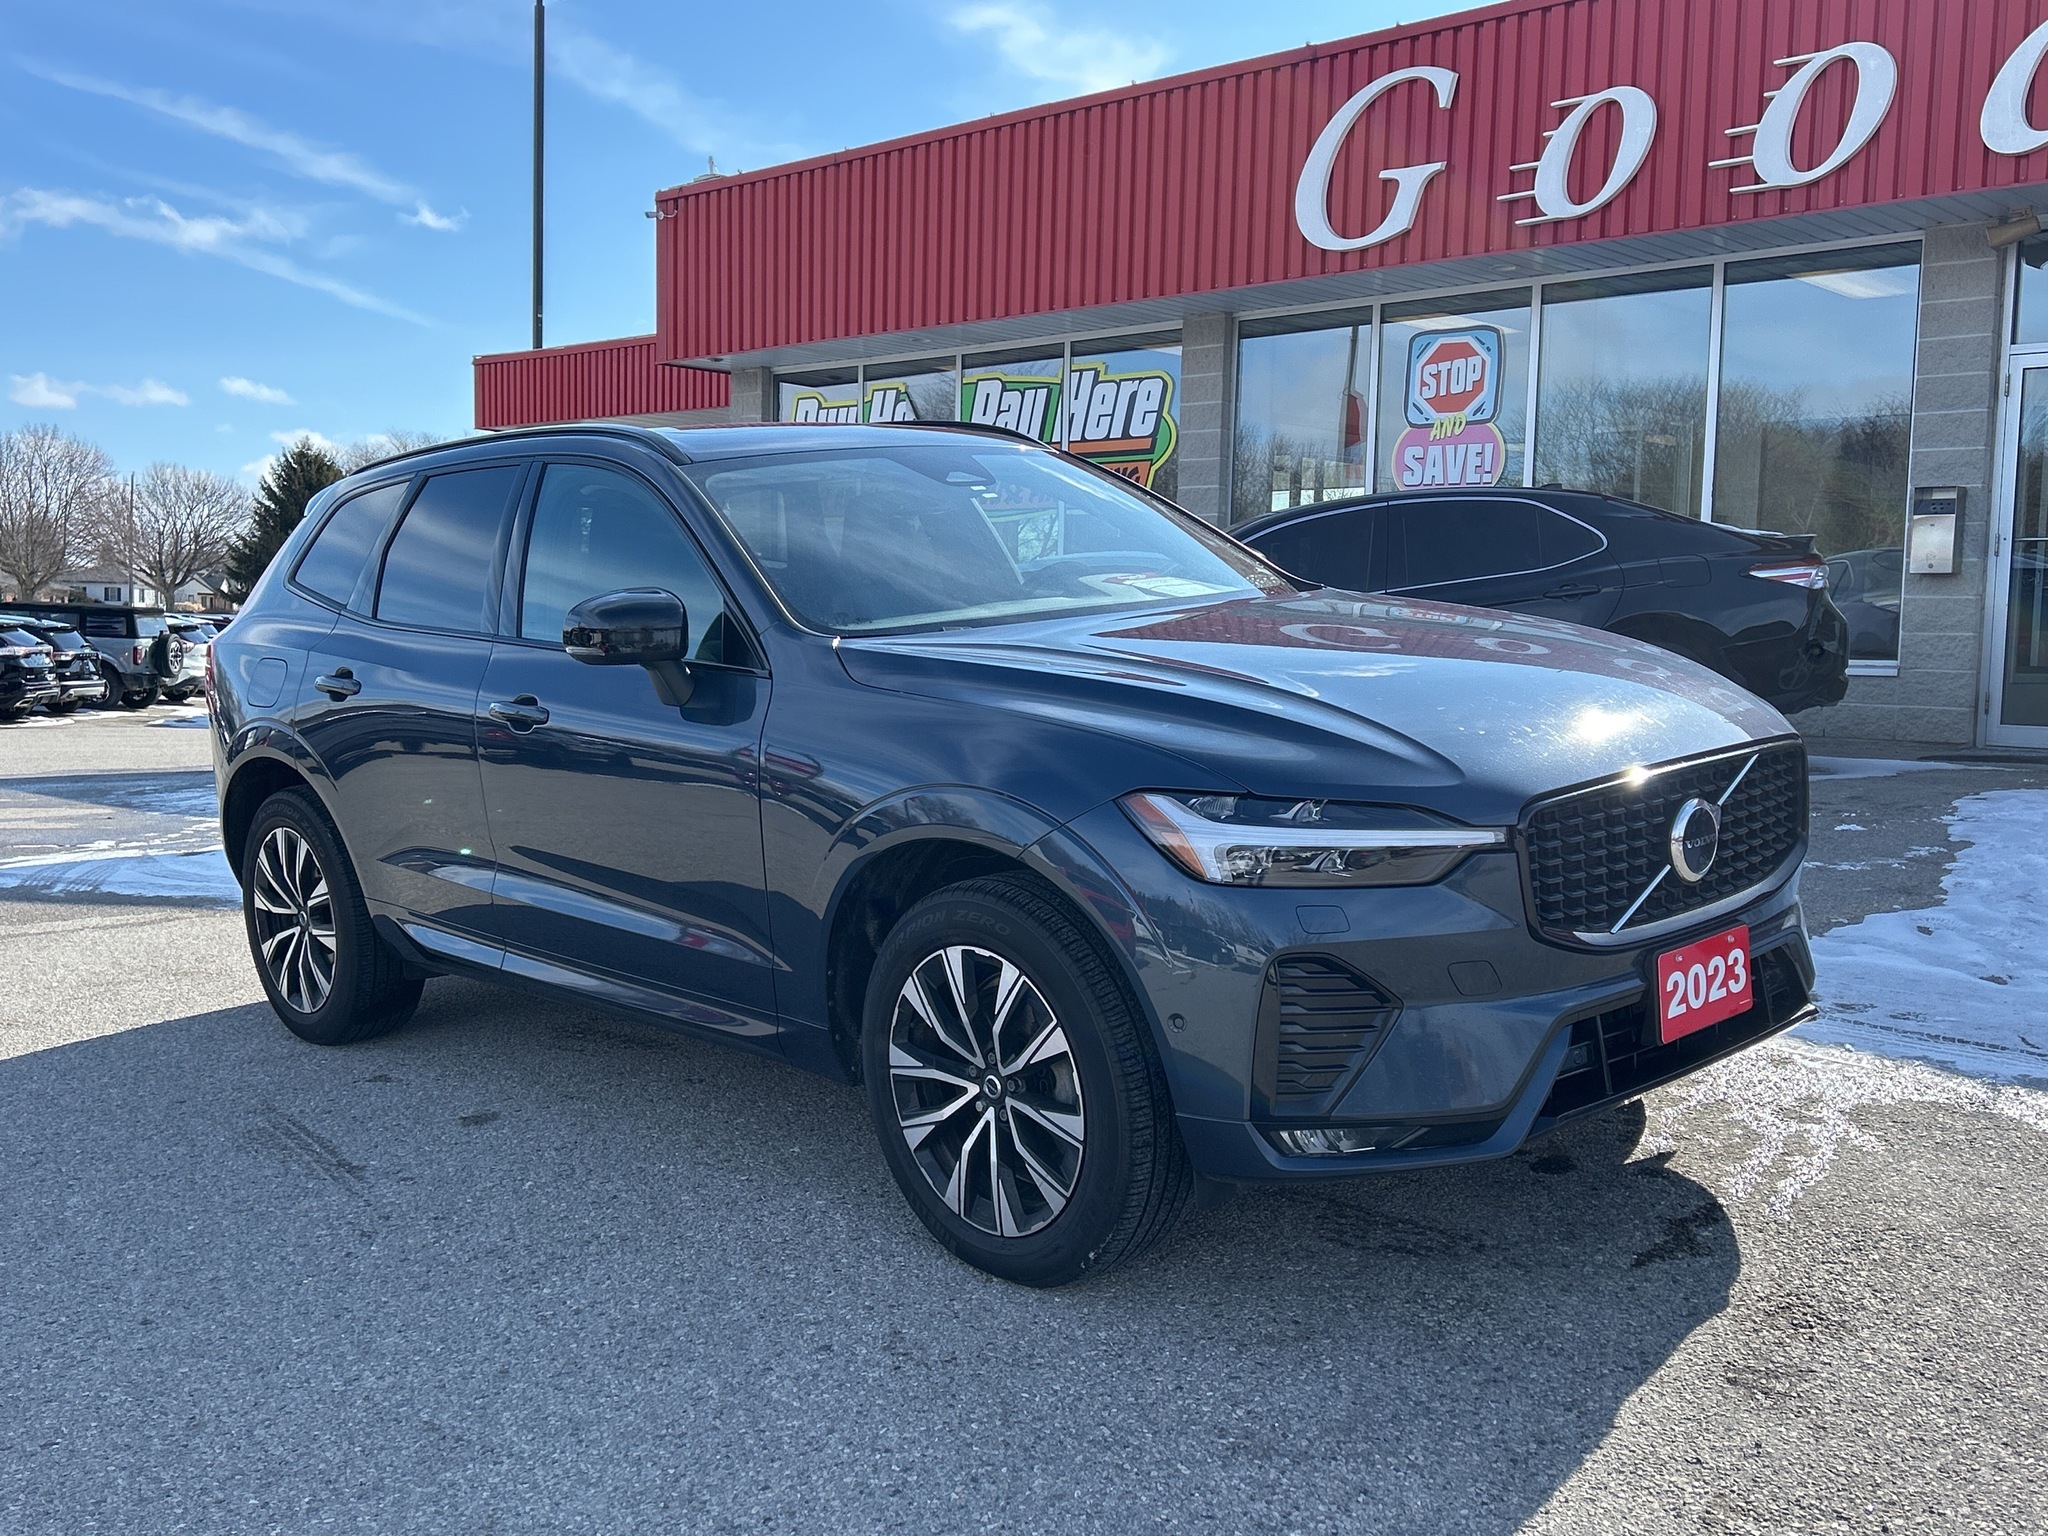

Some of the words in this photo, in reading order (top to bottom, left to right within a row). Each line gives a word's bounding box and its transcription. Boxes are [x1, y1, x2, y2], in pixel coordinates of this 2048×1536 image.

[1421, 355, 1483, 400] STOP
[1052, 370, 1164, 442] Here
[1430, 413, 1467, 442] AND
[1402, 443, 1495, 487] SAVE!
[1684, 832, 1716, 849] VOLVO
[953, 908, 1012, 936] ZERO
[1666, 948, 1747, 1020] 2023
